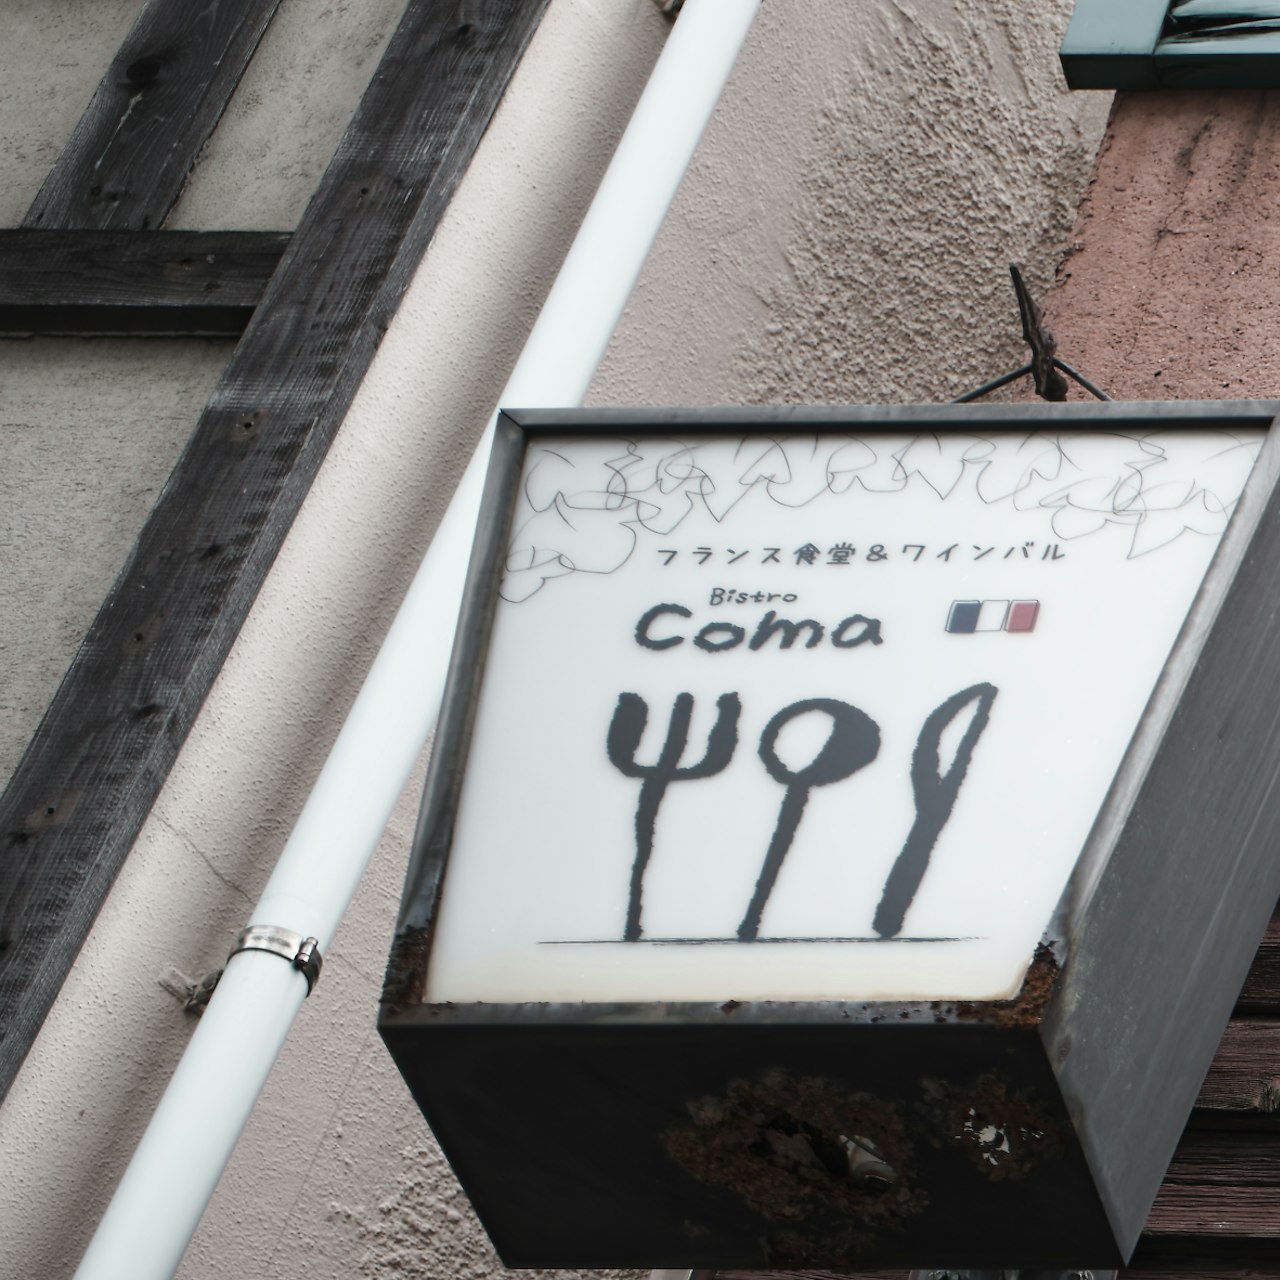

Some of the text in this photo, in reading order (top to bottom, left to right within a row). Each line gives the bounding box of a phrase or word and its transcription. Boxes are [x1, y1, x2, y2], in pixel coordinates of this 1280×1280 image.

[657, 542, 1066, 566] フランス食堂&ワインバル
[709, 587, 798, 606] Bistro
[634, 602, 884, 653] Coma
